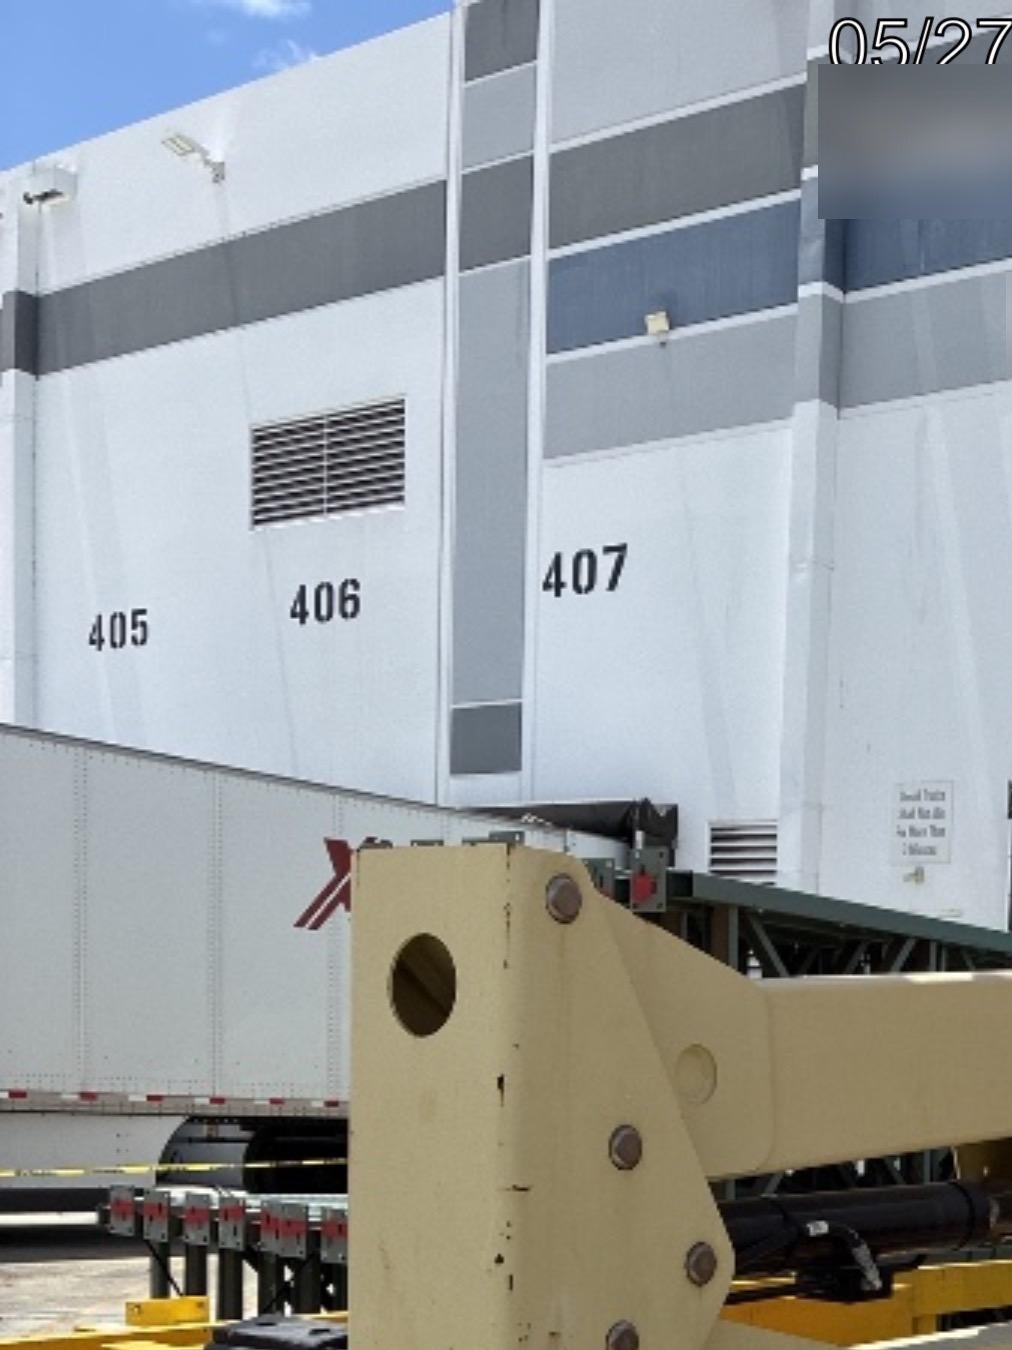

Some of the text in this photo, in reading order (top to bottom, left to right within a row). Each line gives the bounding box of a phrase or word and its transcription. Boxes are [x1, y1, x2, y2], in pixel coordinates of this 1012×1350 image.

[542, 542, 628, 598] 407
[289, 577, 361, 625] 406
[88, 608, 149, 651] 405
